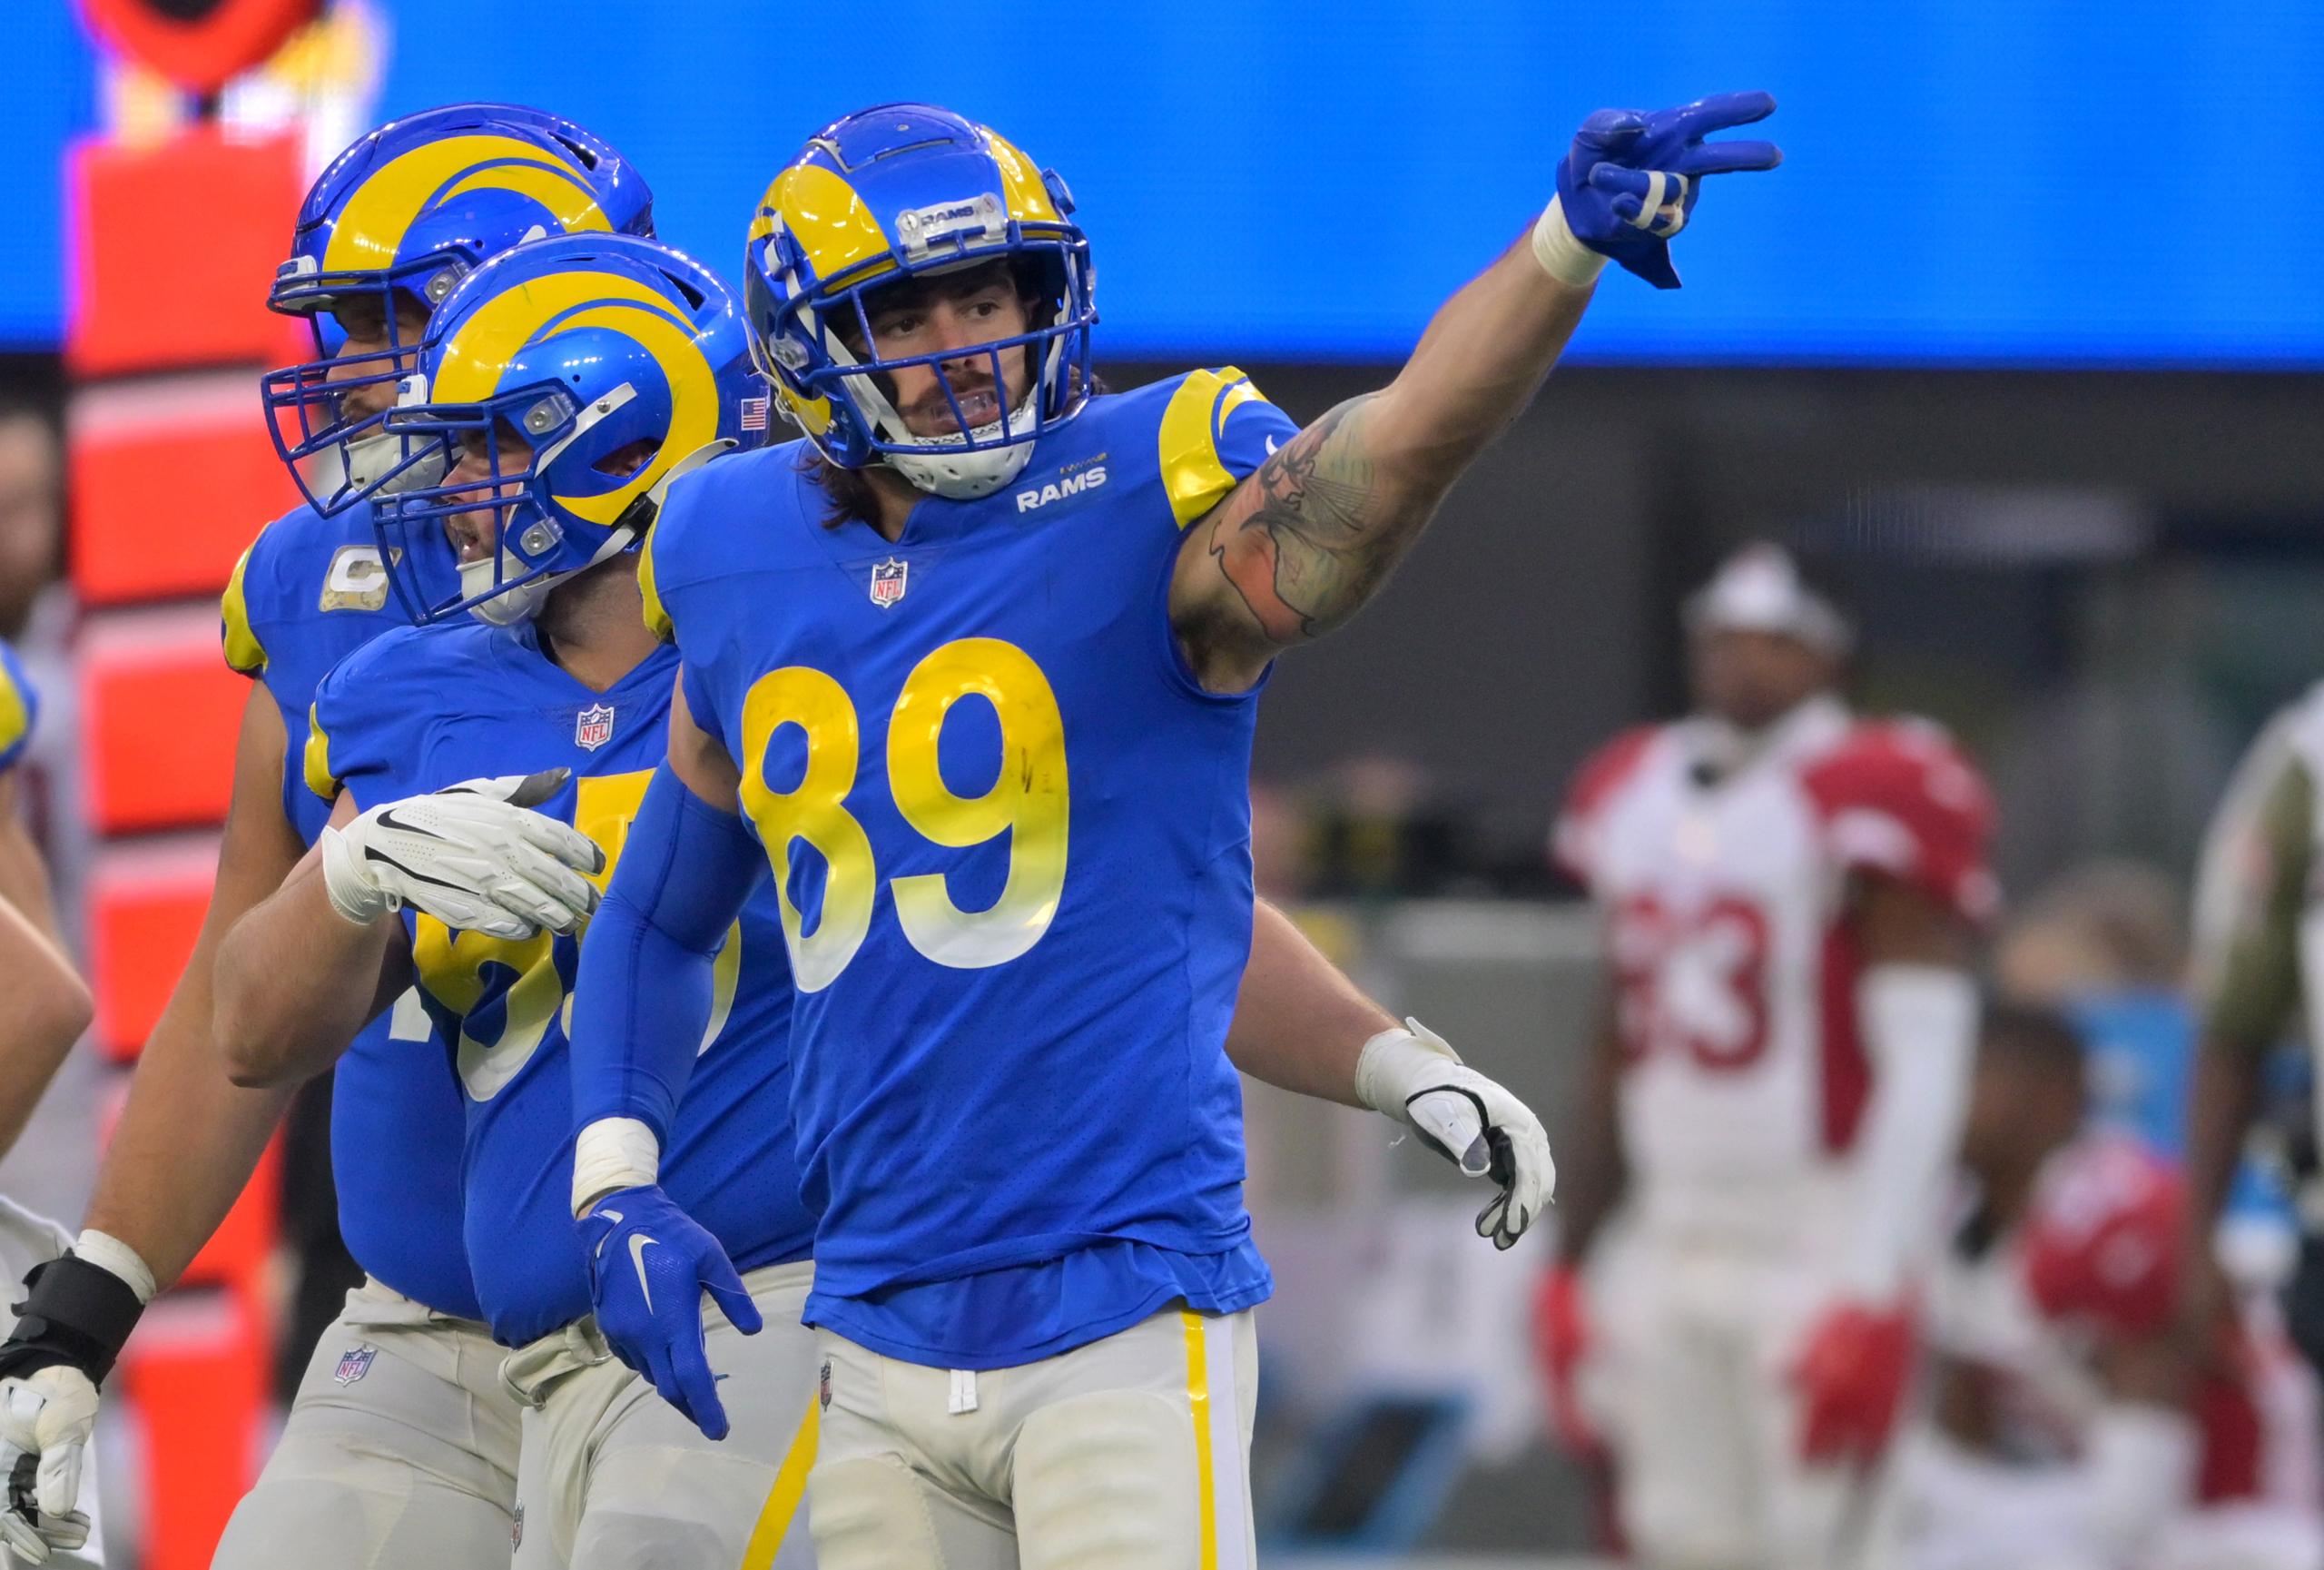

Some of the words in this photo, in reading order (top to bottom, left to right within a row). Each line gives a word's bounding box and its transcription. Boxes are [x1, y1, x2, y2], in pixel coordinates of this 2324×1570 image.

[921, 206, 974, 226] RAMS
[1017, 467, 1107, 513] RAMS
[876, 579, 901, 599] NFL
[582, 724, 606, 742] NFL
[739, 637, 1070, 992] 89
[339, 1362, 362, 1377] NFL
